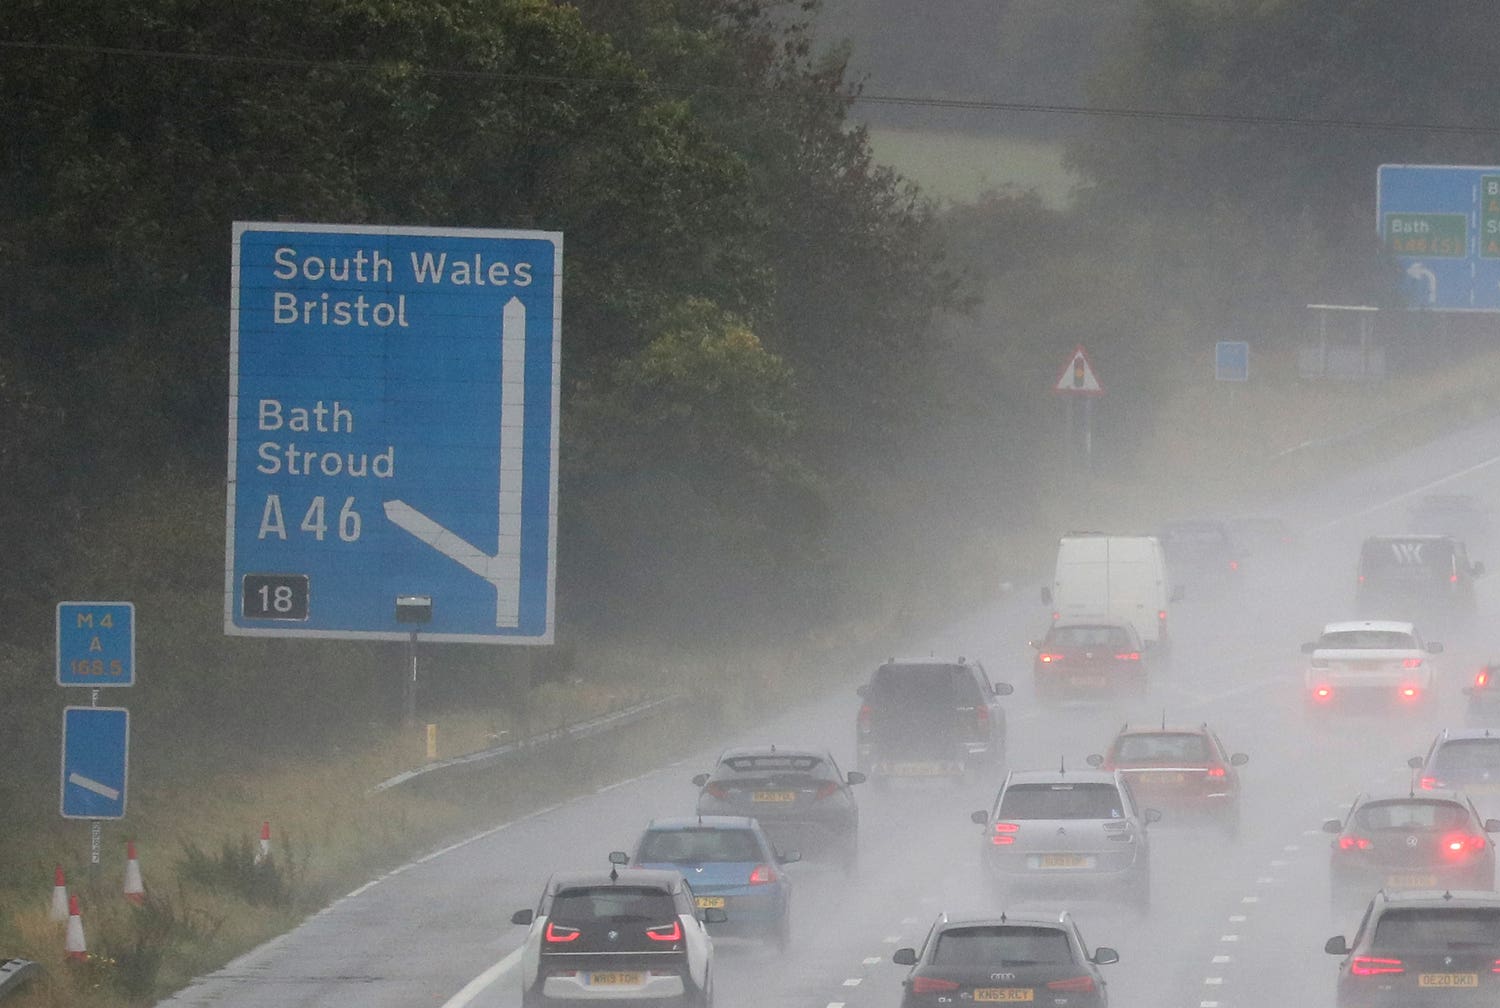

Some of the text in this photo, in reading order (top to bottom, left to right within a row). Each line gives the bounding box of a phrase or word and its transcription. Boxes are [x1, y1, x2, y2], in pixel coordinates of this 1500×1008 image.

[1391, 219, 1430, 233] Bath
[273, 247, 533, 286] South Wales
[272, 291, 409, 328] Bristol
[258, 399, 353, 433] Bath
[256, 441, 395, 478] Stroud
[258, 584, 294, 613] 18
[88, 635, 104, 653] A
